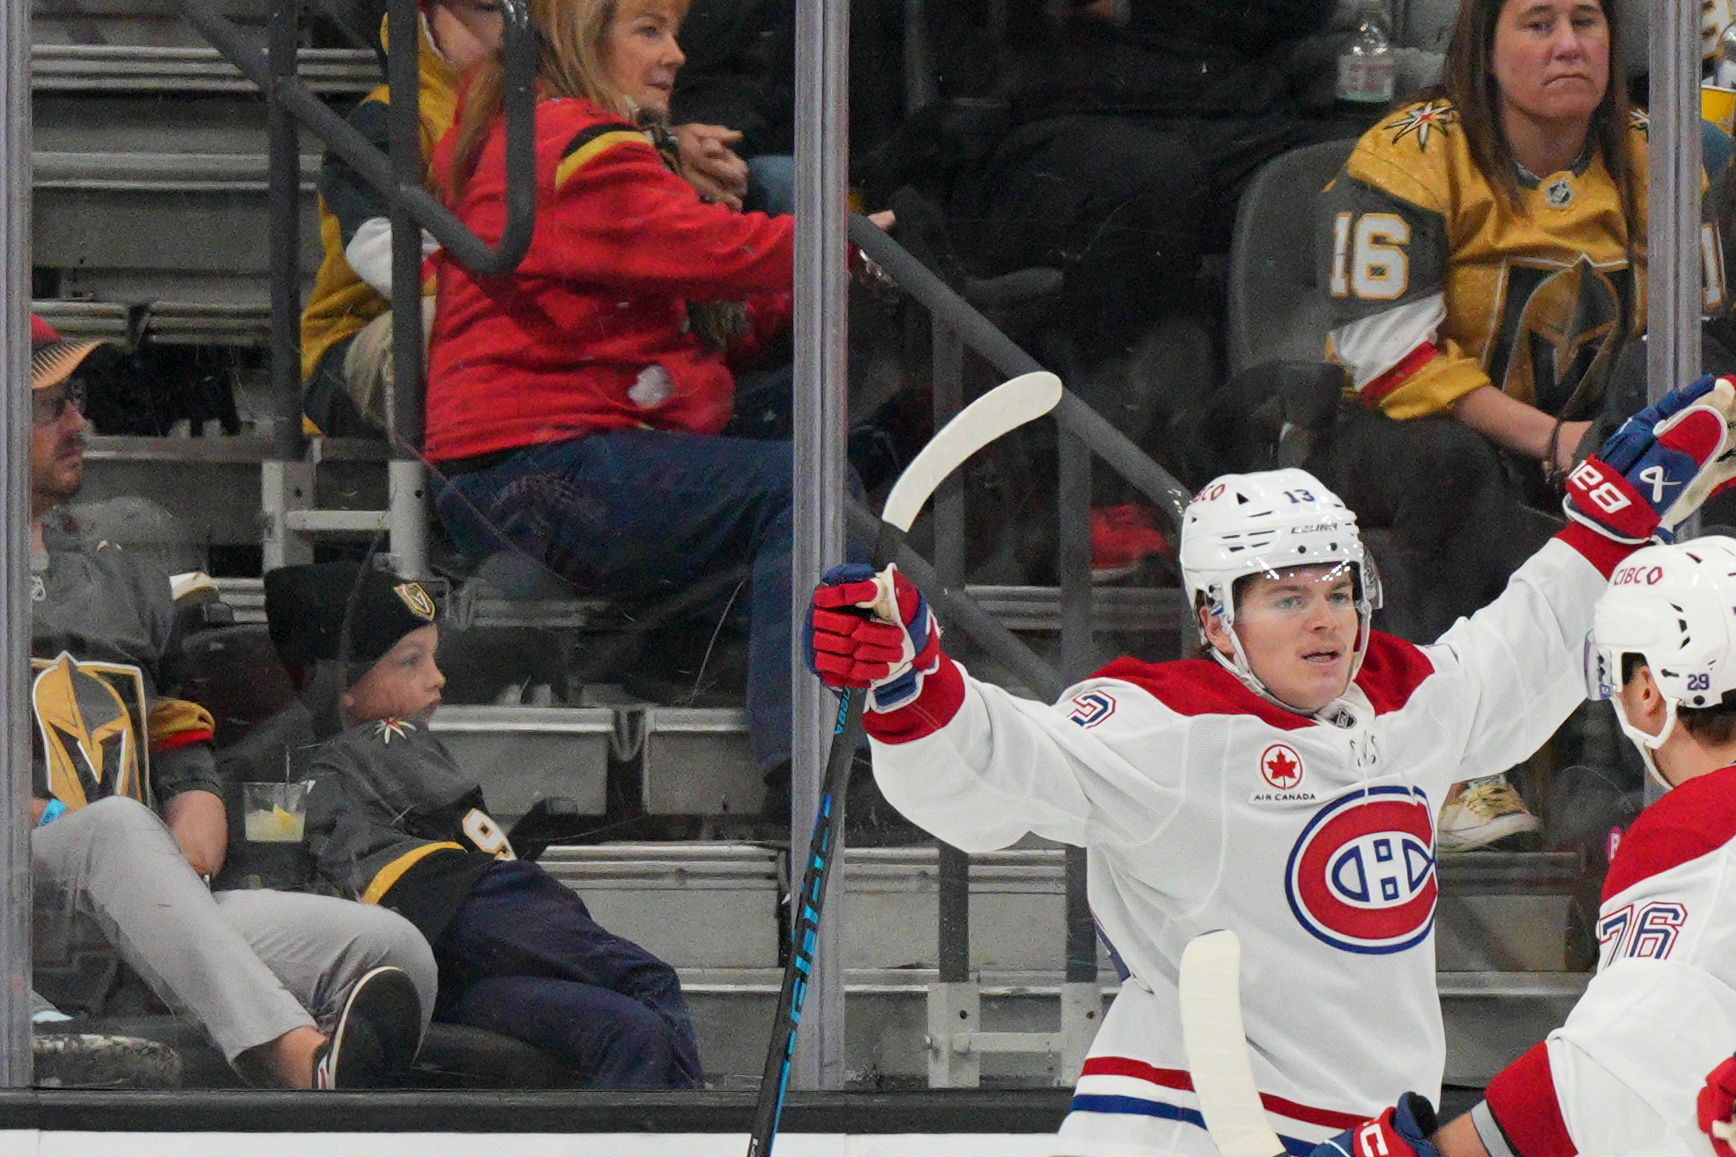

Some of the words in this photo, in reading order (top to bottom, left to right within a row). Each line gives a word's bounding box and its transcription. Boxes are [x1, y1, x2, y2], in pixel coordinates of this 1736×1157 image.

[1330, 211, 1412, 300] 16
[1284, 488, 1316, 504] 13
[1613, 566, 1647, 586] CIBC
[1687, 673, 1710, 691] 29
[1254, 793, 1272, 801] AIR
[1274, 792, 1316, 801] CANADA
[1597, 900, 1688, 970] 76
